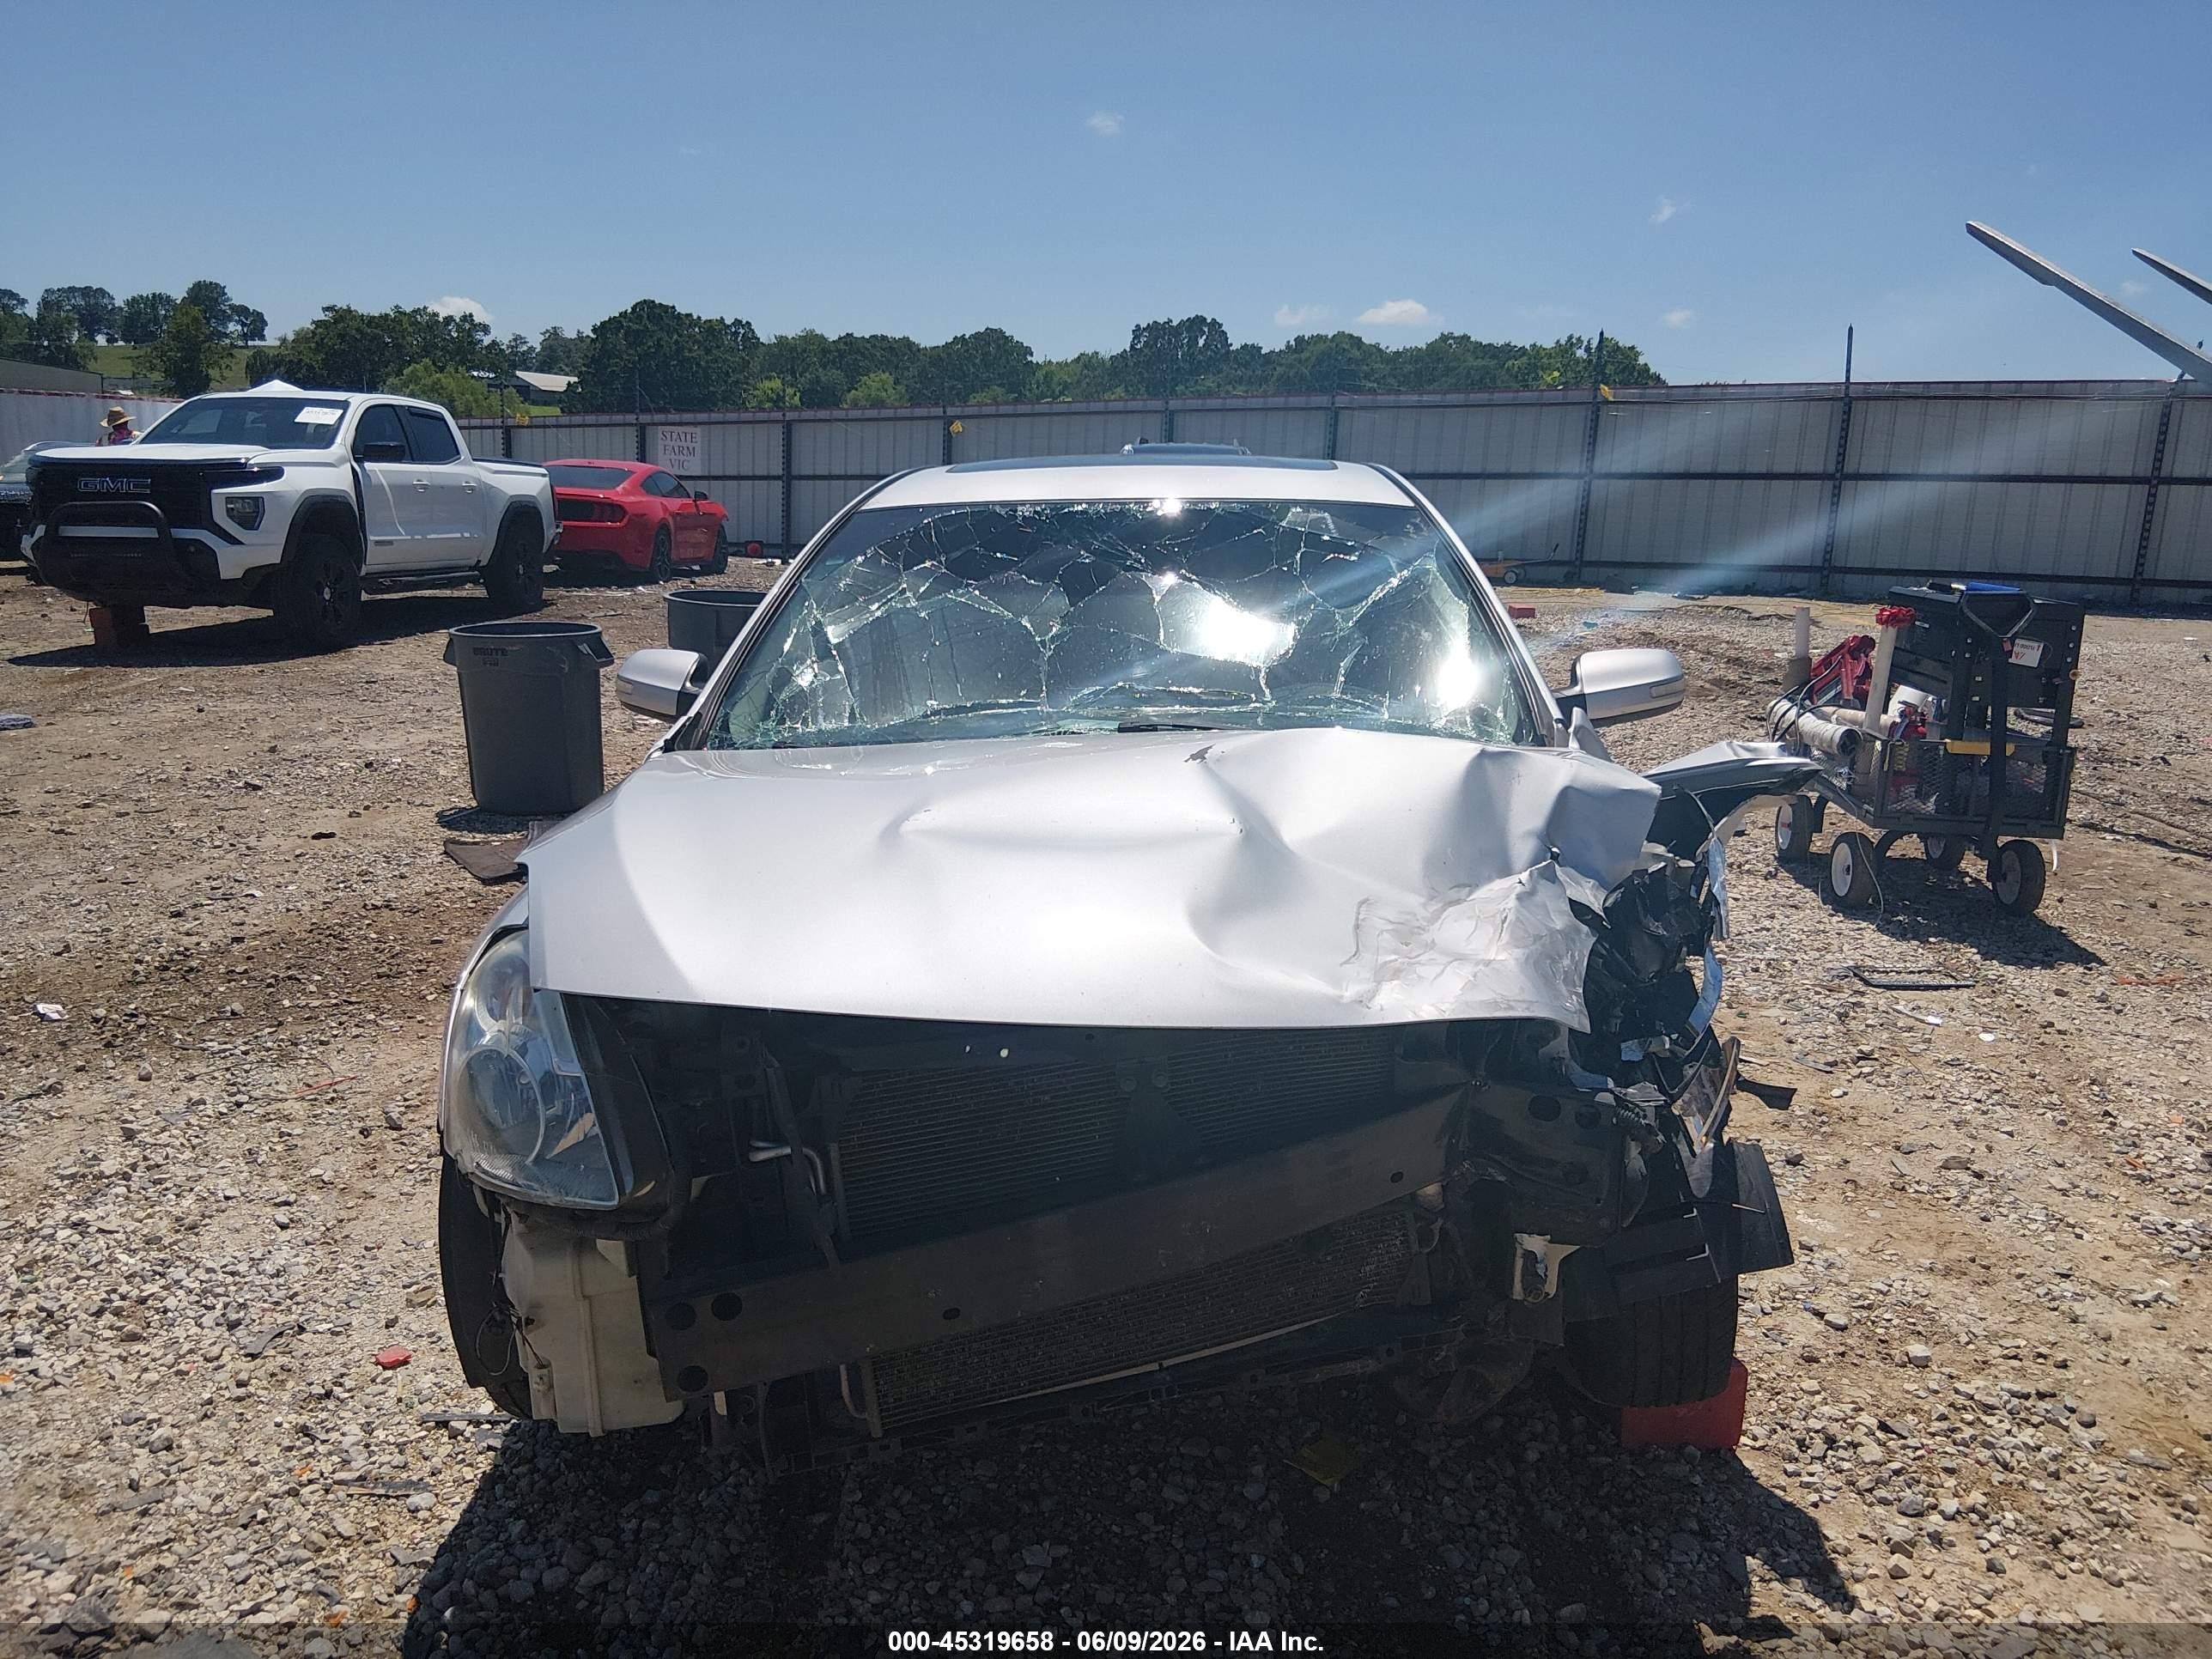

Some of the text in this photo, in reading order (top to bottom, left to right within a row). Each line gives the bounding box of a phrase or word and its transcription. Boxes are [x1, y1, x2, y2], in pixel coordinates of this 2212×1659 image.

[660, 430, 697, 444] STATE
[663, 444, 696, 458] FARM
[669, 458, 690, 471] VIC
[77, 477, 151, 494] GMC
